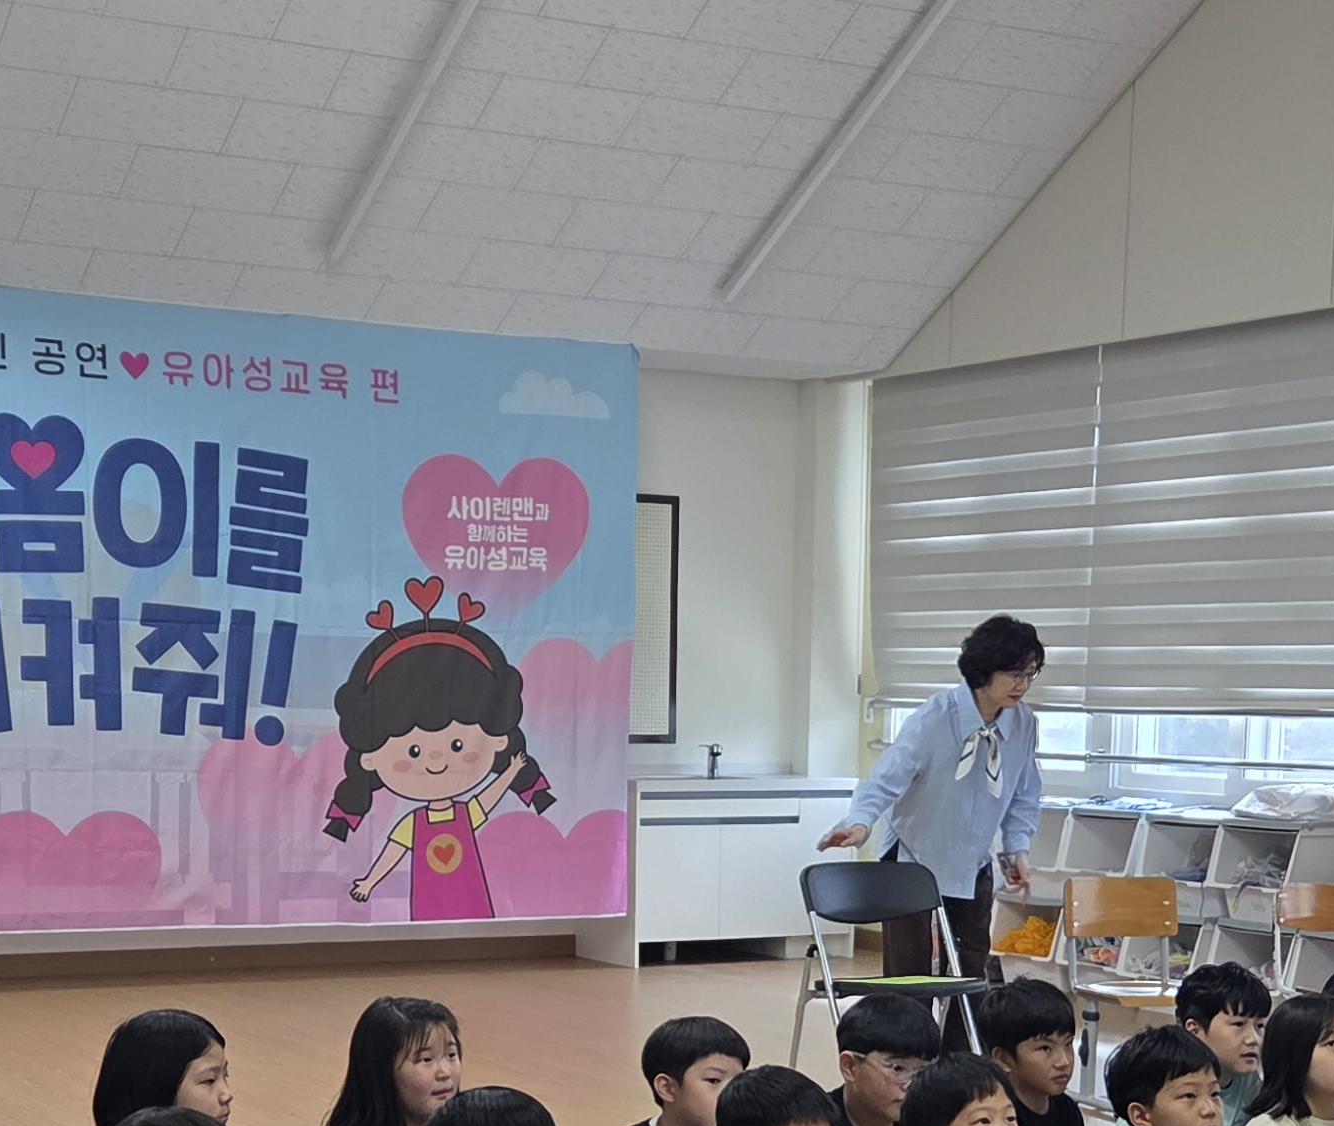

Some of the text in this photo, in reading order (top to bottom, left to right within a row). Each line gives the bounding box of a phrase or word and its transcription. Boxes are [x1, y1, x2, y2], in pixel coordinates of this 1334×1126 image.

[31, 336, 109, 380] 공연
[162, 350, 349, 400] 유아성교육
[370, 367, 400, 404] 편
[447, 495, 550, 522] 사이렌맨과
[467, 523, 529, 543] 함께하는
[444, 545, 549, 572] 유아성교육
